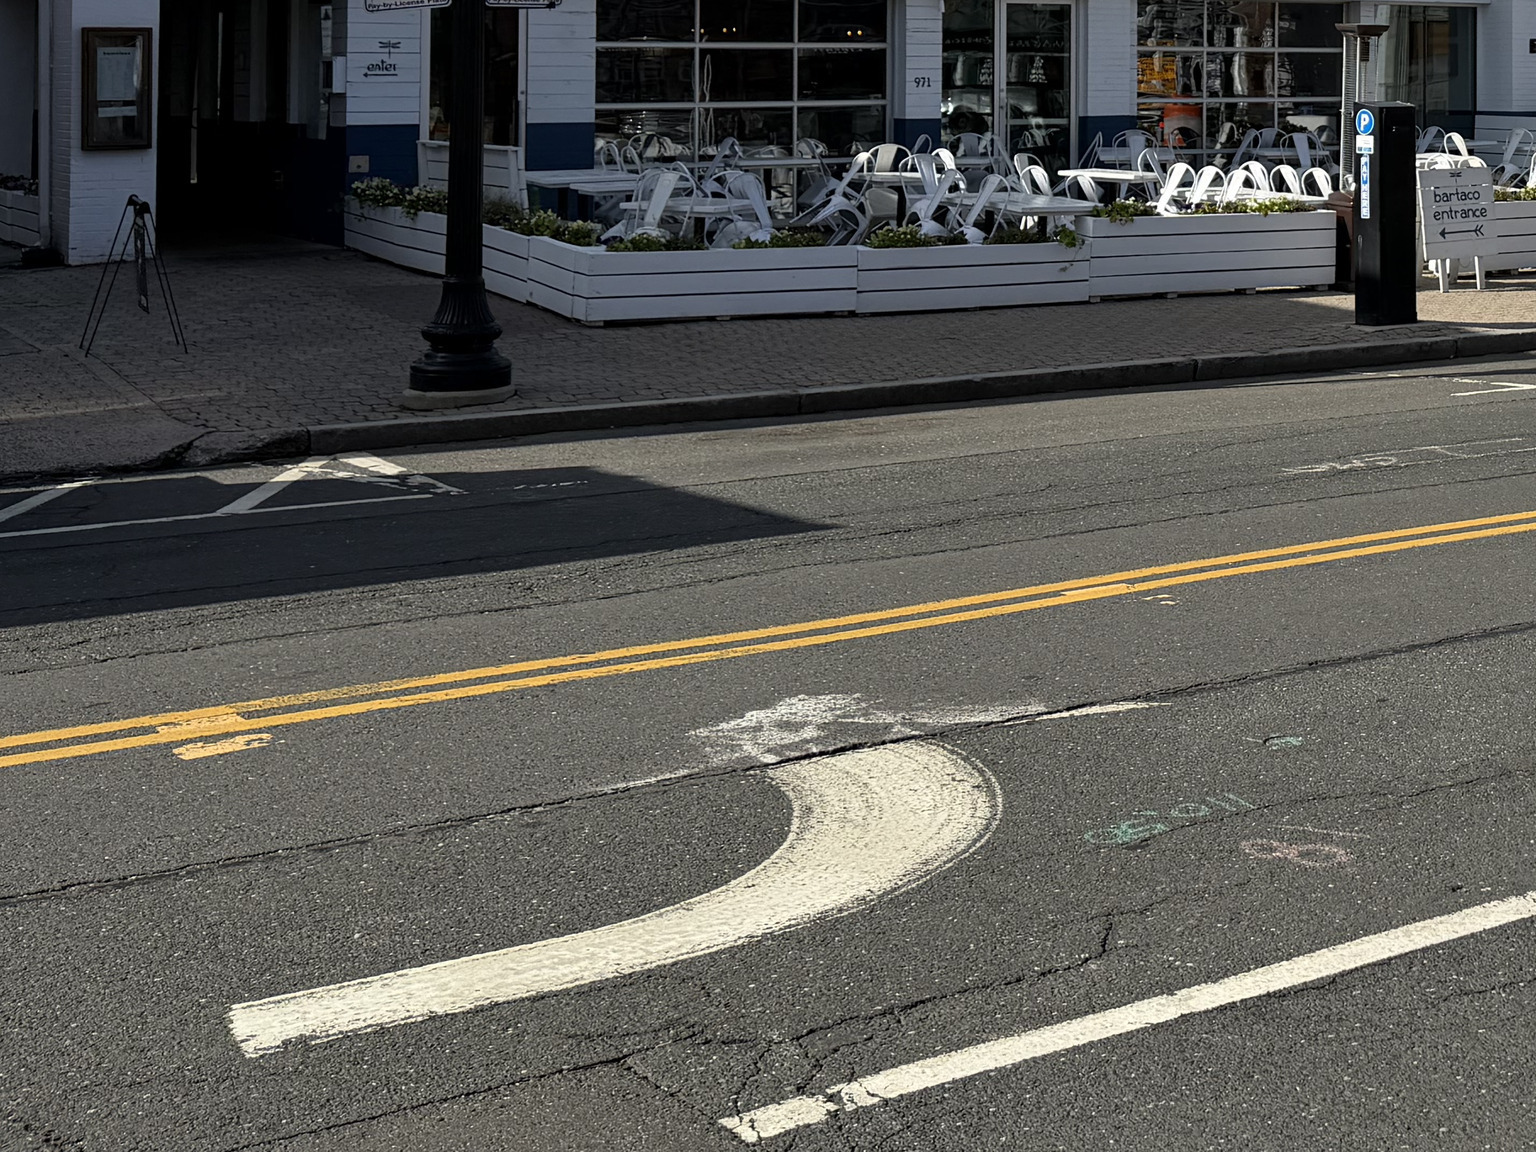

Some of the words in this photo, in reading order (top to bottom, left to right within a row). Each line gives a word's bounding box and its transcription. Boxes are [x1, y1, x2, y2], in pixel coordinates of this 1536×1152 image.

[368, 0, 425, 10] Pay-by-License
[367, 59, 397, 72] enter
[914, 76, 931, 88] 971
[1361, 114, 1370, 131] P
[1433, 188, 1480, 203] bartaco
[1433, 206, 1487, 221] entrance
